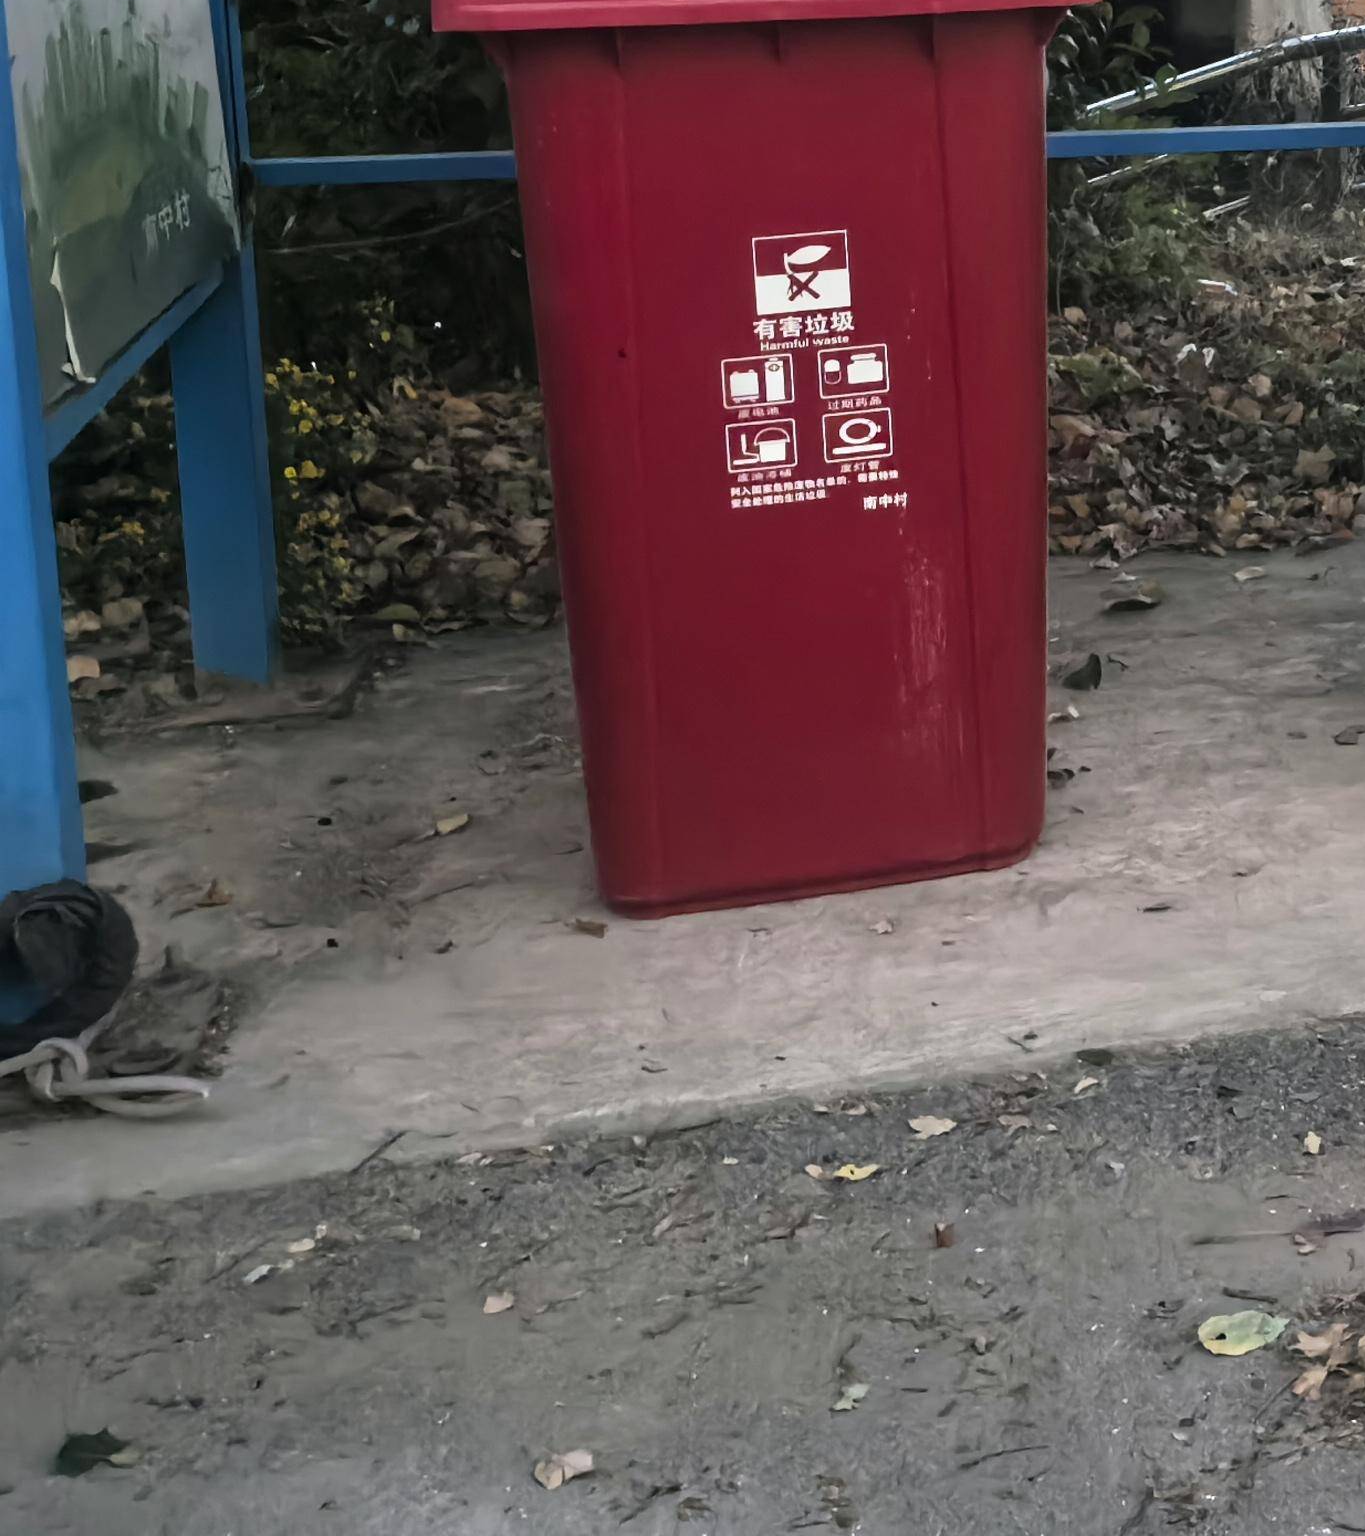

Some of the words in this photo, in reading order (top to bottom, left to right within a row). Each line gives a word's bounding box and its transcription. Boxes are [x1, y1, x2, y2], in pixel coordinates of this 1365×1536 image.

[753, 311, 855, 340] 有害垃圾
[760, 337, 809, 352] Harmful
[812, 334, 850, 348] waste
[863, 492, 908, 511] 南中村
